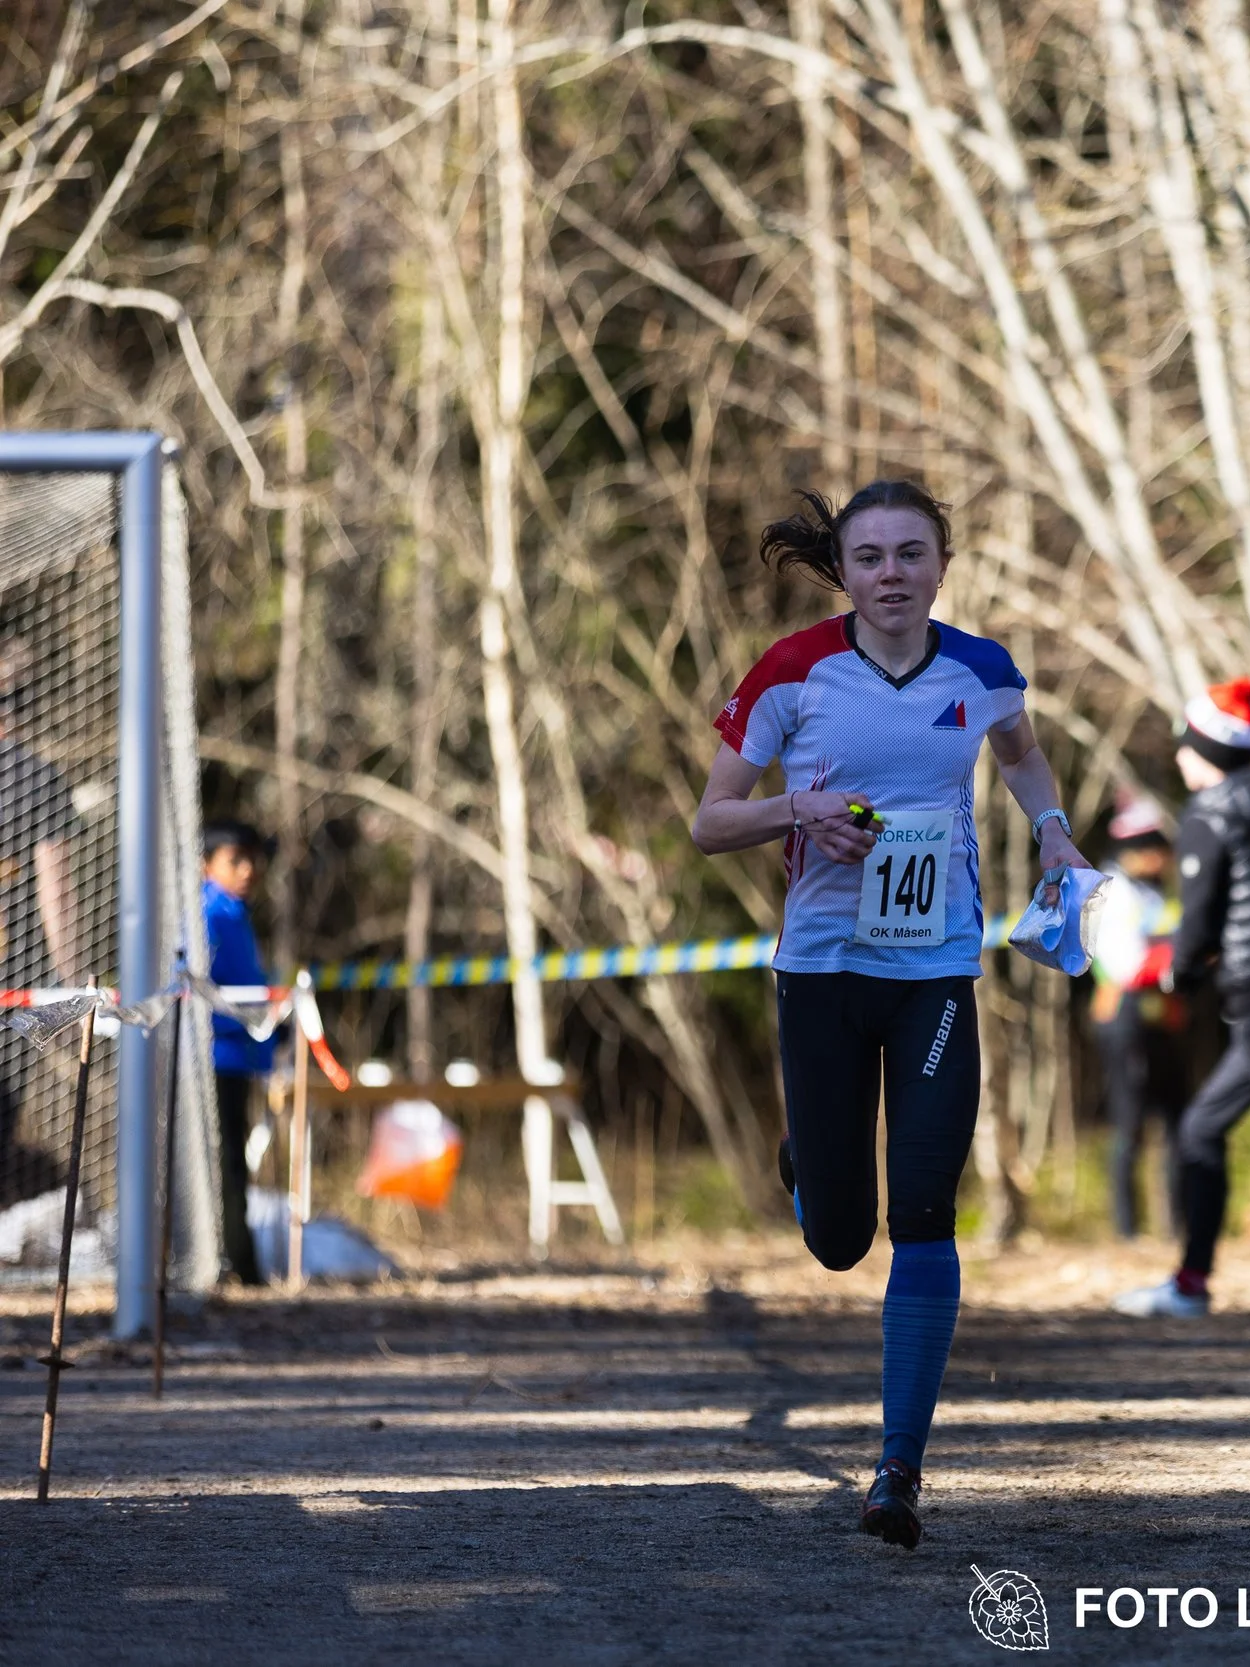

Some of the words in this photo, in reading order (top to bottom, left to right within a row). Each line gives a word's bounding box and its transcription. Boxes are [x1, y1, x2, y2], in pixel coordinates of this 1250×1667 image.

[876, 853, 936, 917] 140
[870, 927, 891, 938] OK
[893, 926, 932, 938] Måsen
[922, 998, 957, 1077] noname
